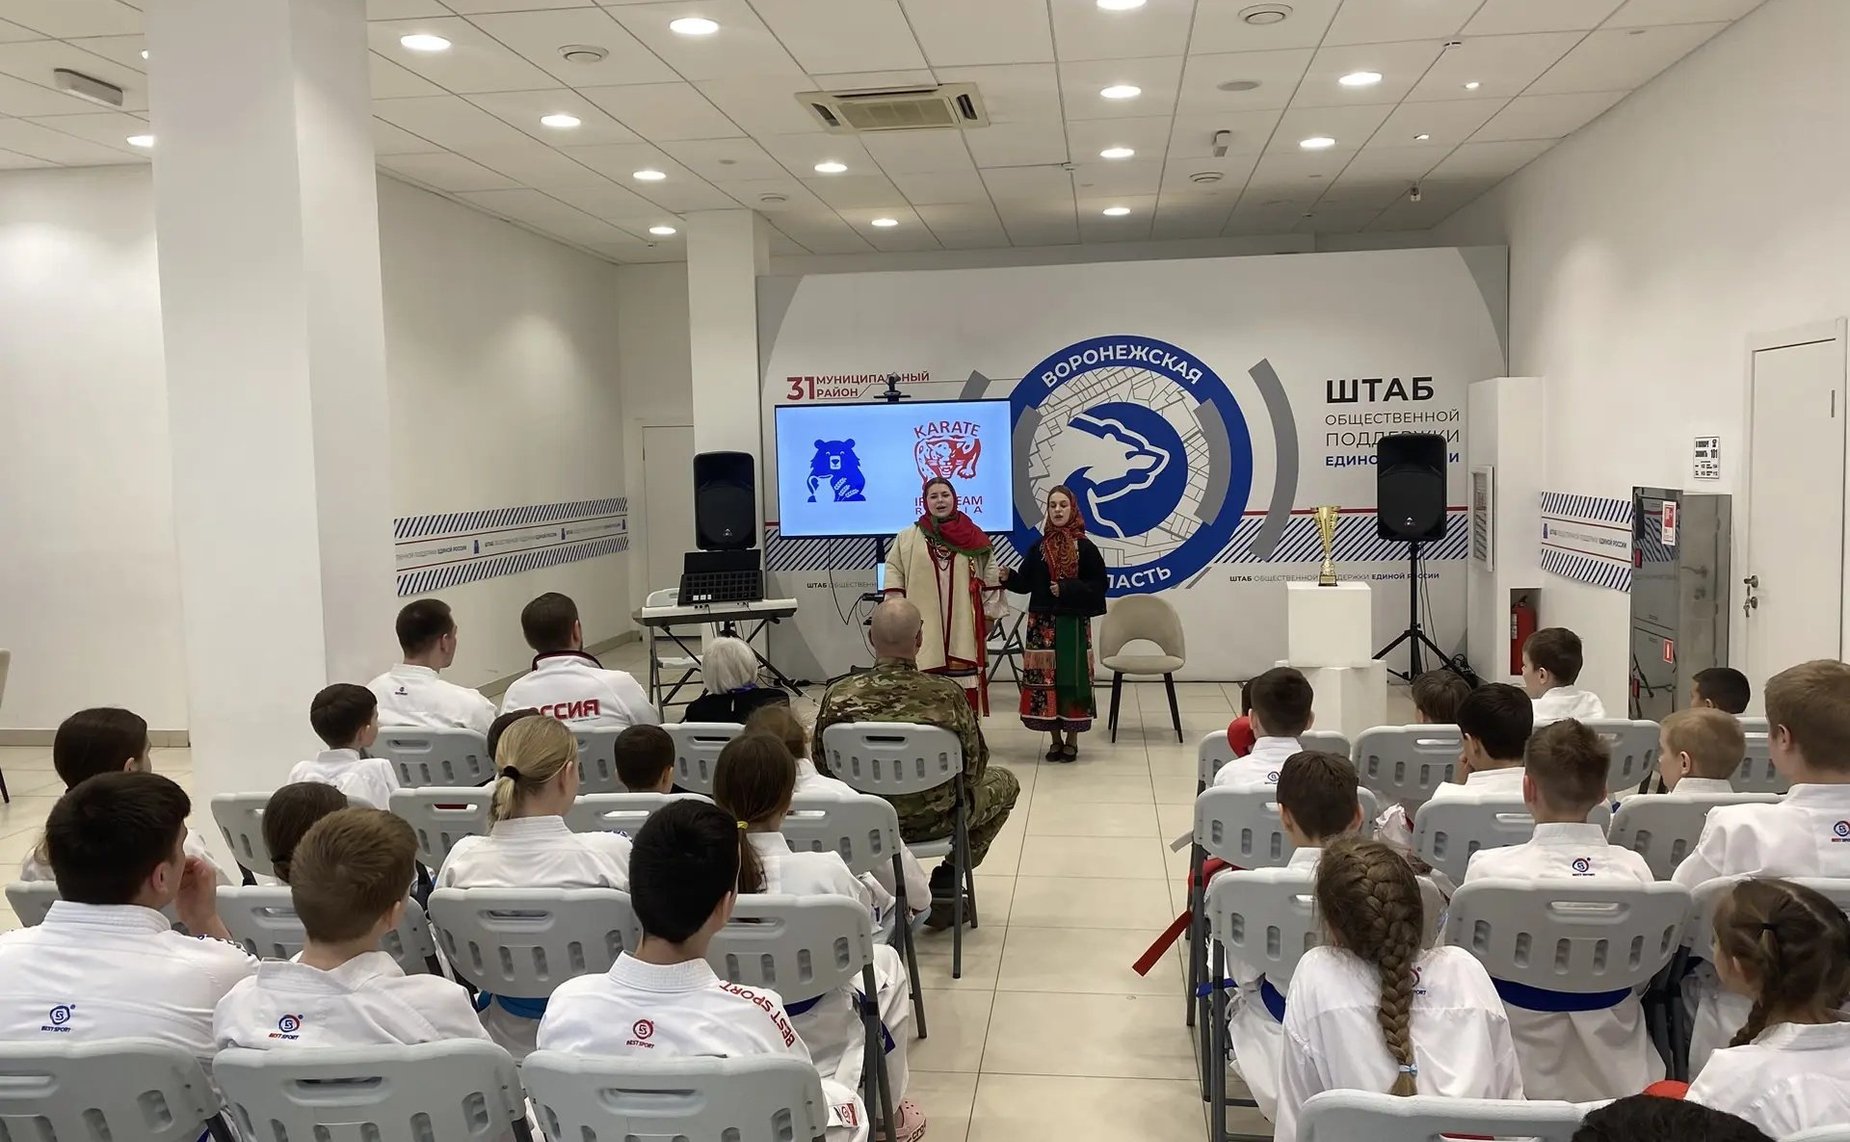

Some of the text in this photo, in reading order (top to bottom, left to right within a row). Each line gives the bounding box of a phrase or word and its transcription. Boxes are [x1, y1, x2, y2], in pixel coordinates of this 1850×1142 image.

[1041, 344, 1203, 388] ВОРОНЕЖСКАЯ
[787, 372, 930, 400] 31 МУНИЦИПАНЫЙ
[816, 384, 858, 398] РАЙОН
[1326, 376, 1434, 404] ШТАБ
[1325, 407, 1460, 426] ОБЩЕСТВЕННОЙ
[914, 420, 981, 439] KARATE
[1325, 455, 1379, 468] ЕДИНО
[957, 495, 983, 506] EAM
[1107, 566, 1172, 589] ЛАСТЬ
[1253, 572, 1319, 583] ОБЩЕСТВЕННОЙ
[1371, 572, 1405, 580] ЕДИНОЙ
[1407, 572, 1440, 580] РССИИ
[541, 700, 600, 719] ССИЯ
[719, 983, 796, 1048] BEST SPORT
[639, 1041, 655, 1049] SPORT
